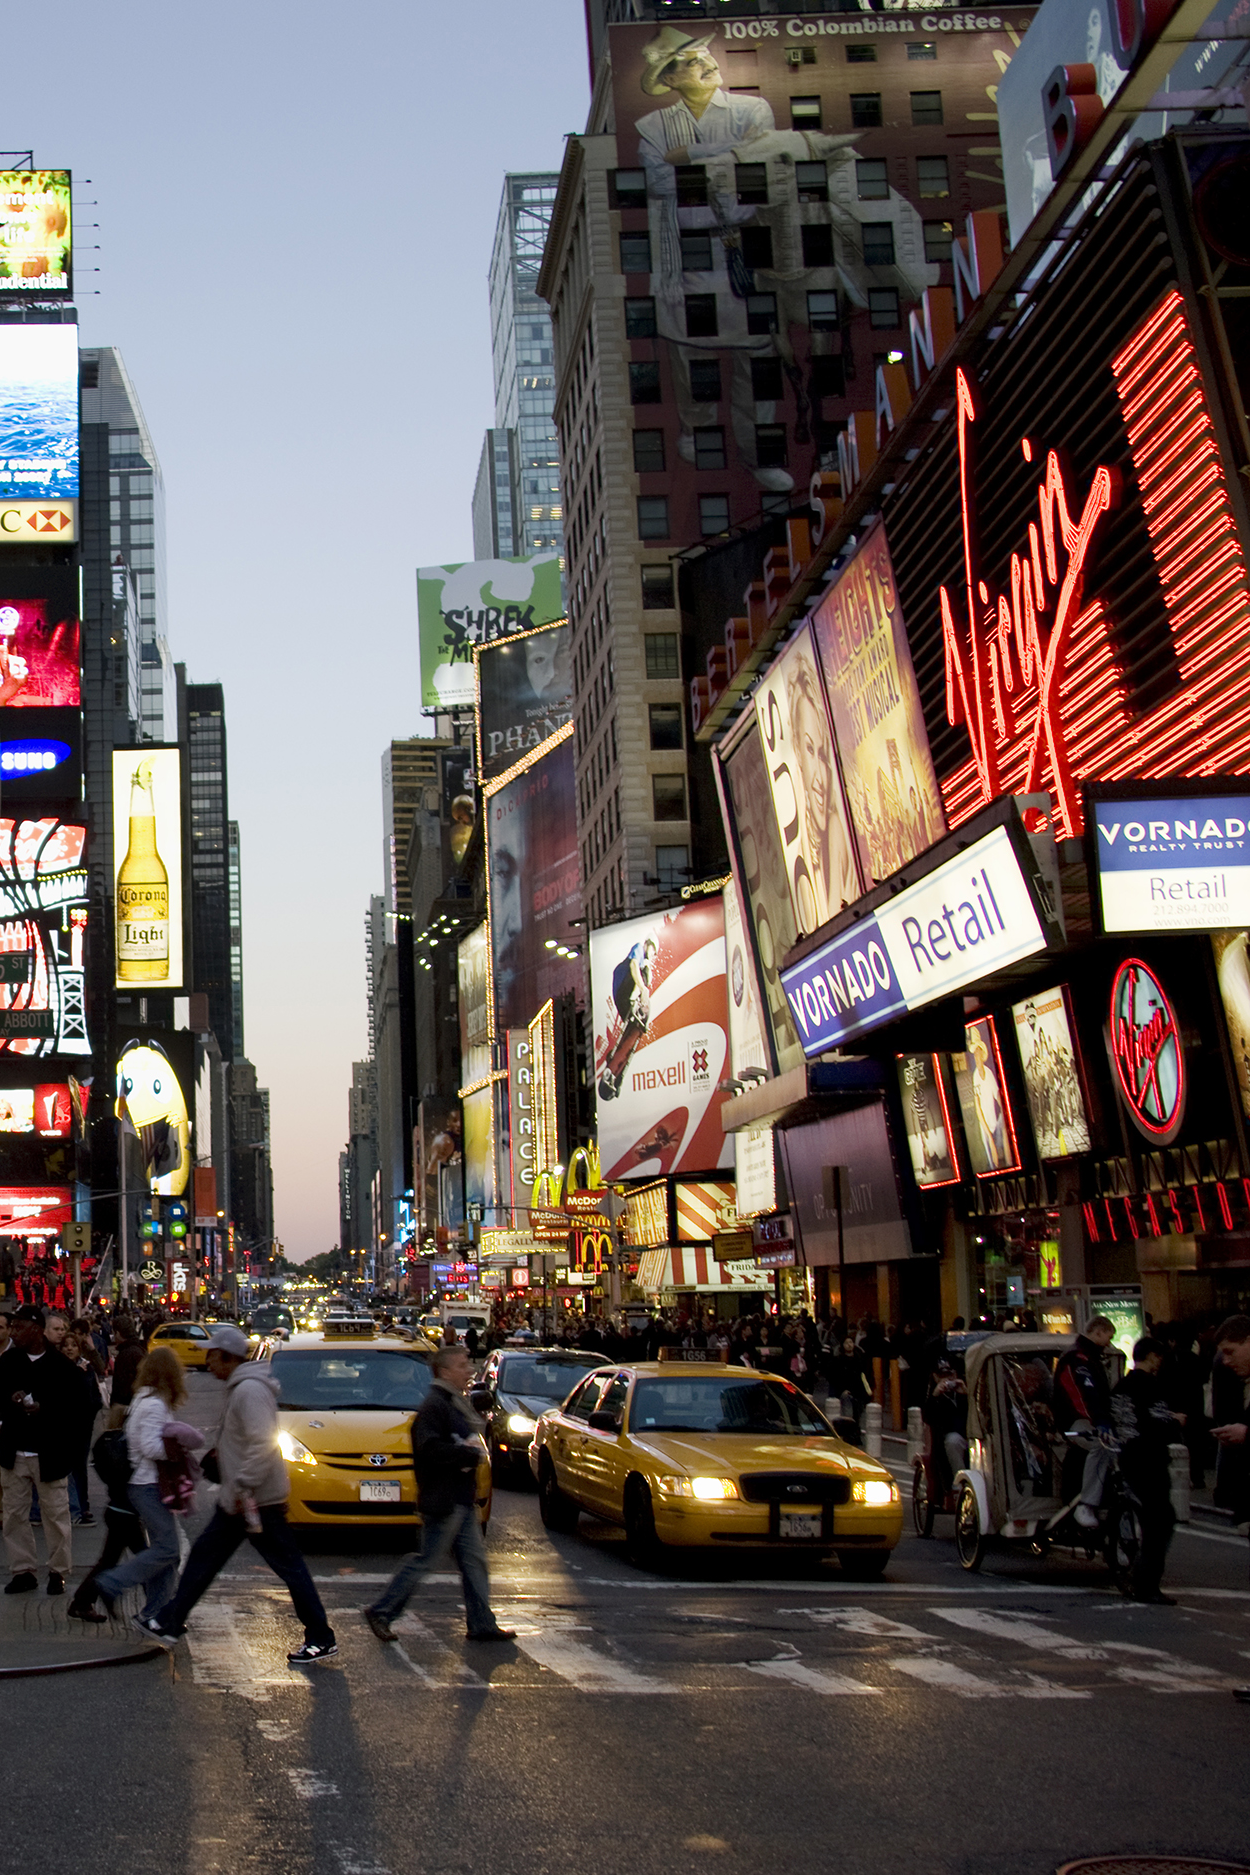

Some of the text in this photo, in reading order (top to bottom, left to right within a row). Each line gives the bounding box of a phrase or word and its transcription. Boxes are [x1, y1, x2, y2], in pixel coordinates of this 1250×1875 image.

[722, 13, 1002, 38] 100% Colombian Coffee
[4, 227, 35, 243] life
[440, 604, 536, 647] SHREK
[1097, 818, 1250, 846] VORNAD
[1128, 840, 1245, 853] REALTY TRUST
[121, 887, 166, 906] Corona
[1150, 873, 1227, 901] Retail
[1153, 902, 1230, 917] 212.894.7000
[902, 868, 1007, 973] Retail
[1154, 915, 1232, 928] www.vno.com
[124, 923, 164, 945] Light
[11, 956, 26, 969] ST
[787, 941, 892, 1038] VORNADO
[4, 1012, 50, 1029] ABBOTT
[632, 1060, 687, 1092] maxell
[692, 1073, 710, 1082] GAMES
[516, 1041, 535, 1186] PALACE
[344, 1168, 352, 1220] WELLINGTON
[497, 1236, 535, 1246] LEGALLY
[534, 1231, 550, 1239] OPEN
[681, 1350, 707, 1362] 1G56
